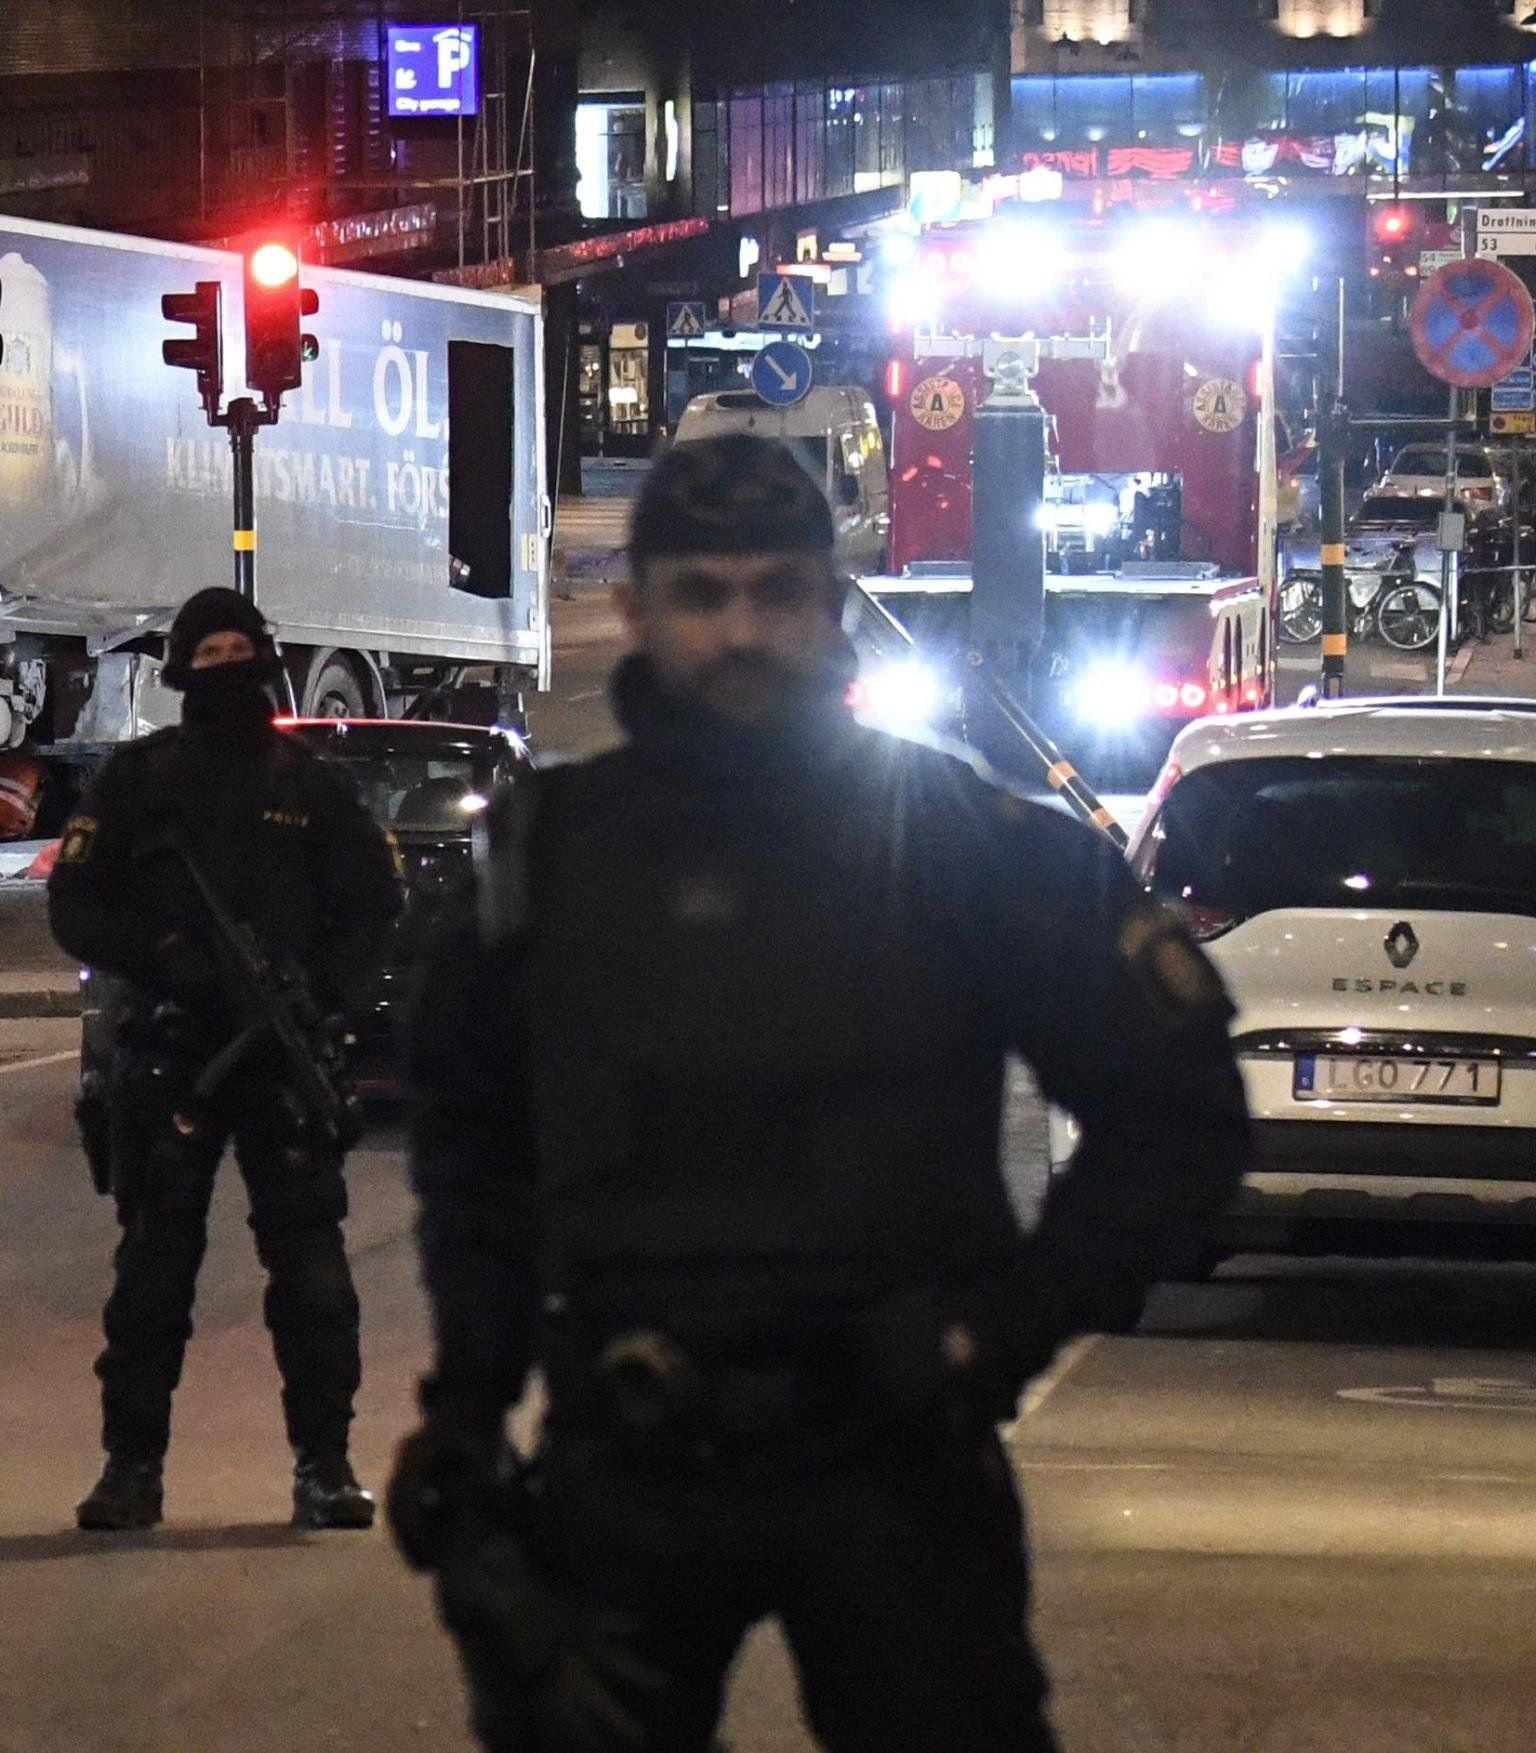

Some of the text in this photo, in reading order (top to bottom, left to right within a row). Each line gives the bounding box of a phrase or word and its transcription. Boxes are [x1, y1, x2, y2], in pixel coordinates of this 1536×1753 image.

[1481, 238, 1497, 251] 53
[1331, 977, 1467, 997] ESPACE
[1410, 1060, 1480, 1093] 771
